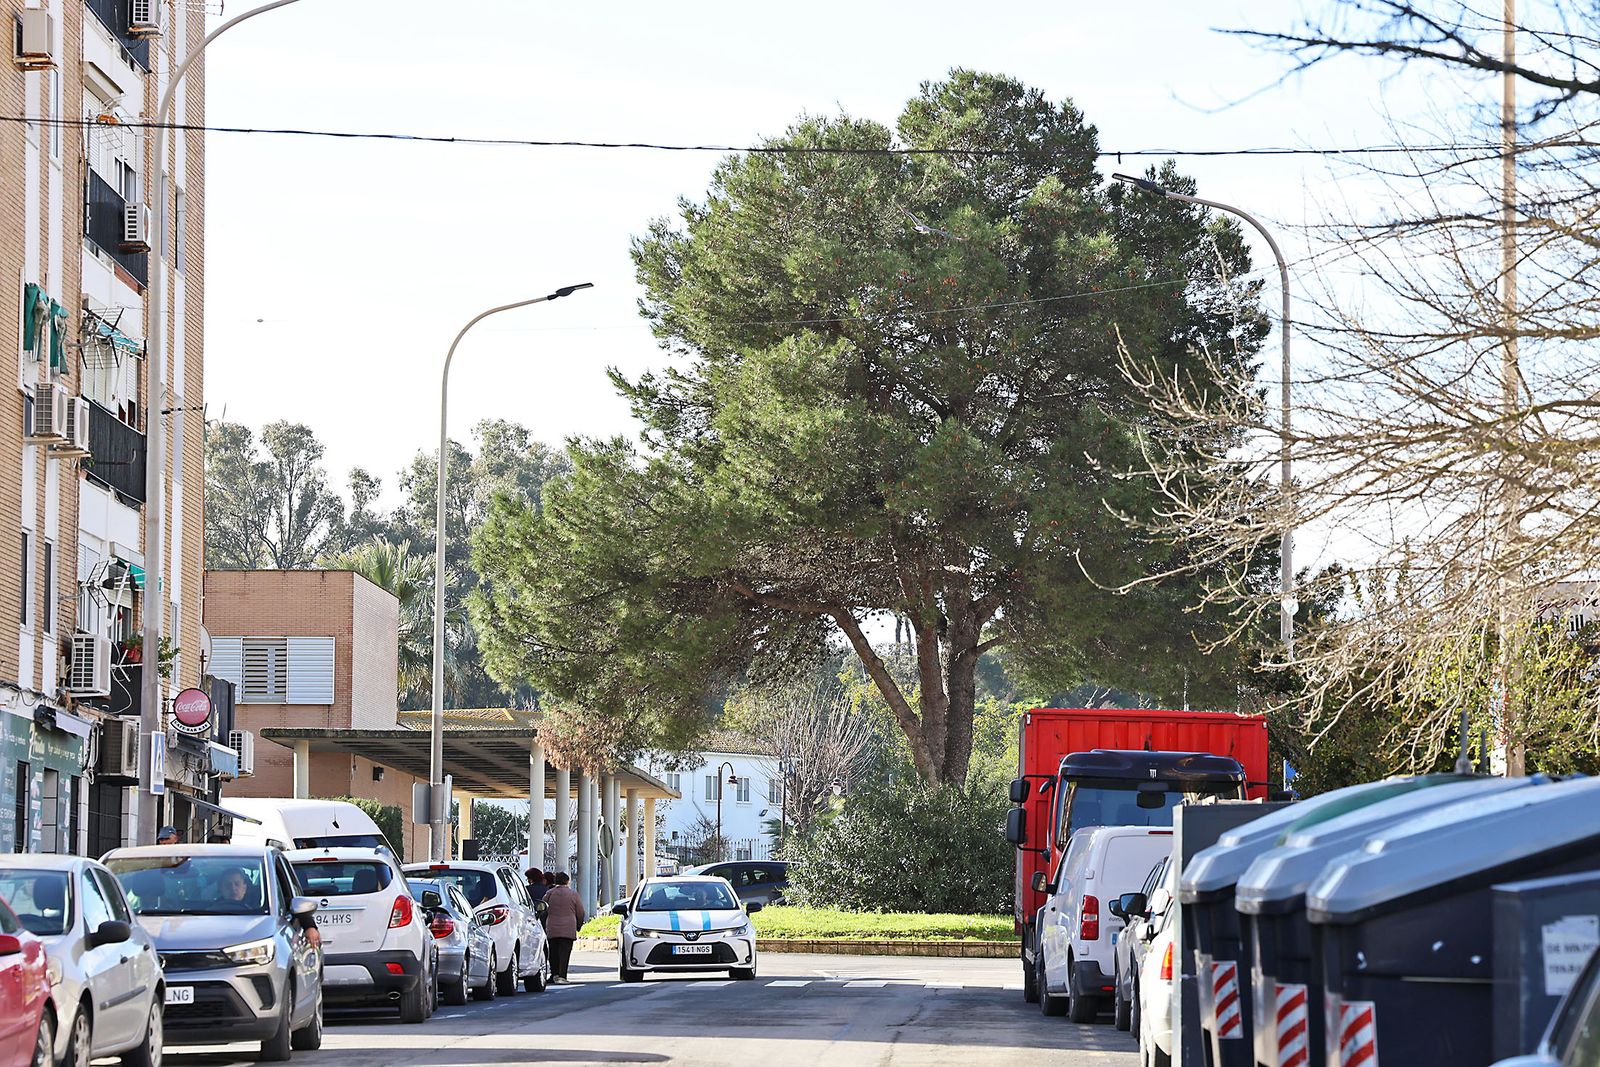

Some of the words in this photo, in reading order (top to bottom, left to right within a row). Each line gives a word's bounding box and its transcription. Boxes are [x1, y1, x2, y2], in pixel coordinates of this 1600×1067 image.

[175, 700, 208, 713] Coca-Cola
[313, 915, 328, 925] 94
[332, 914, 352, 924] HYS
[696, 945, 710, 953] NGS
